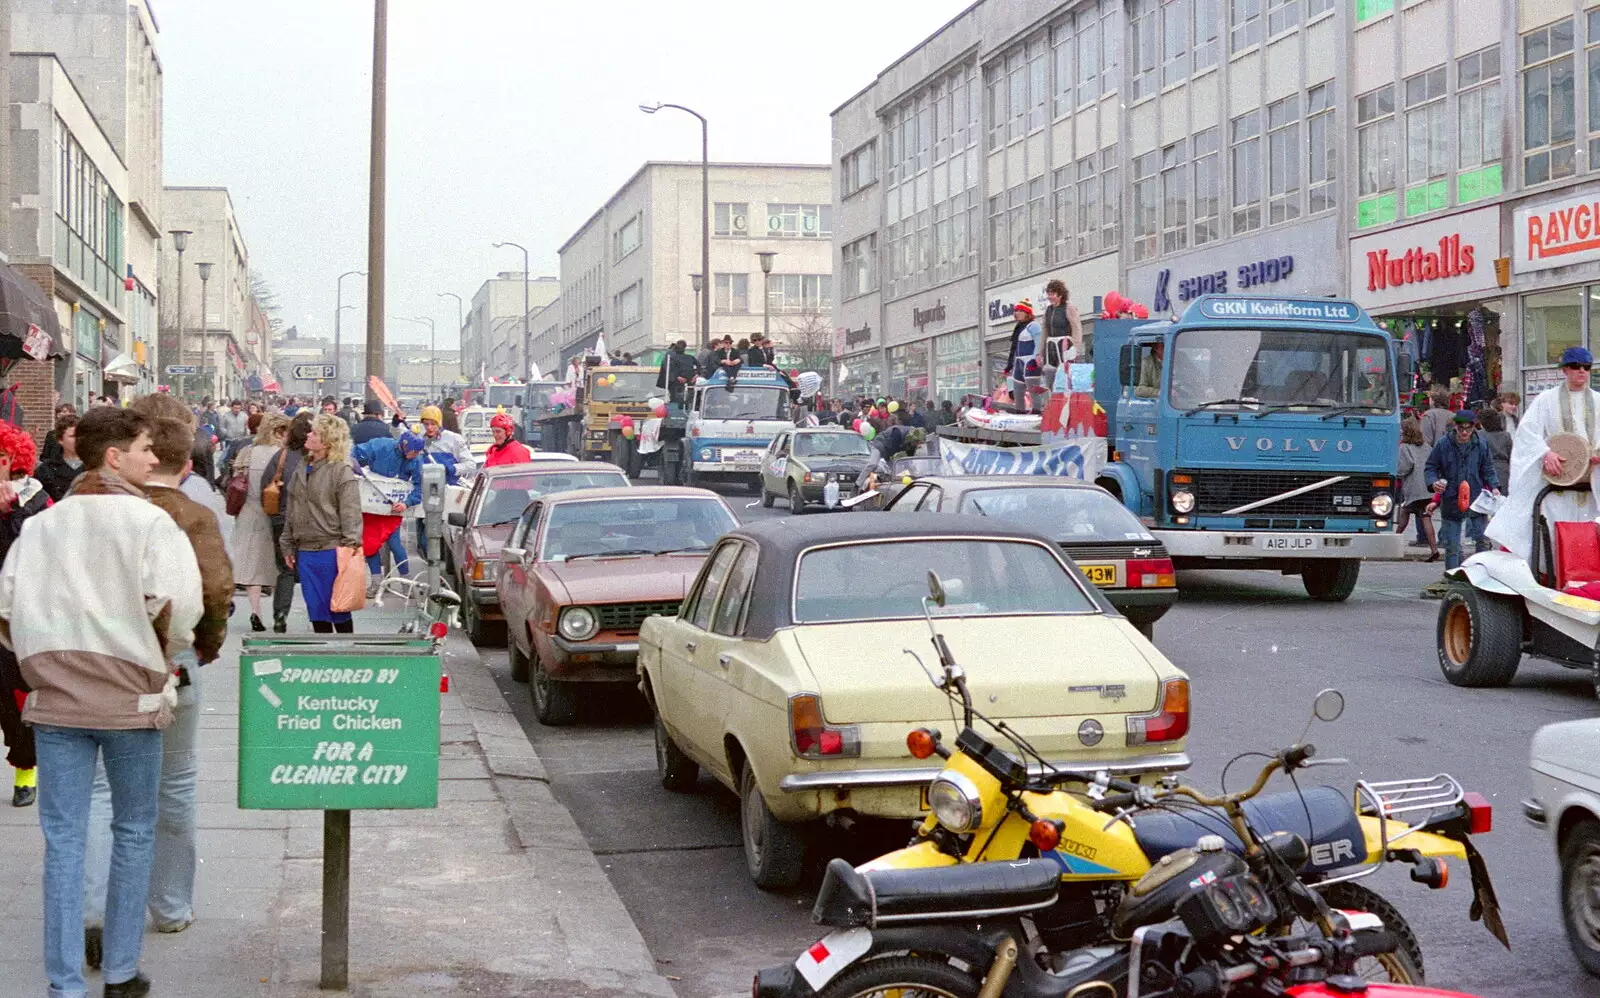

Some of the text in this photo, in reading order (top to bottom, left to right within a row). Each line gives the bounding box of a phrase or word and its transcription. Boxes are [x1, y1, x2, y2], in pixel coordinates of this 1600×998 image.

[1367, 233, 1475, 292] Nuttalls
[1154, 255, 1294, 312] K SHOE SHOP
[1212, 301, 1248, 314] GKN
[1250, 302, 1322, 317] Kwikform
[325, 367, 332, 377] P
[1224, 436, 1353, 453] VOLVO
[1267, 538, 1313, 549] A121 JLP
[1082, 567, 1113, 582] 43W
[280, 668, 399, 684] SPONSORED BY
[297, 696, 379, 713] Kentucky
[277, 714, 402, 730] Fried Chicken
[313, 741, 374, 761] FOR A
[270, 764, 408, 784] CLEANER CITY
